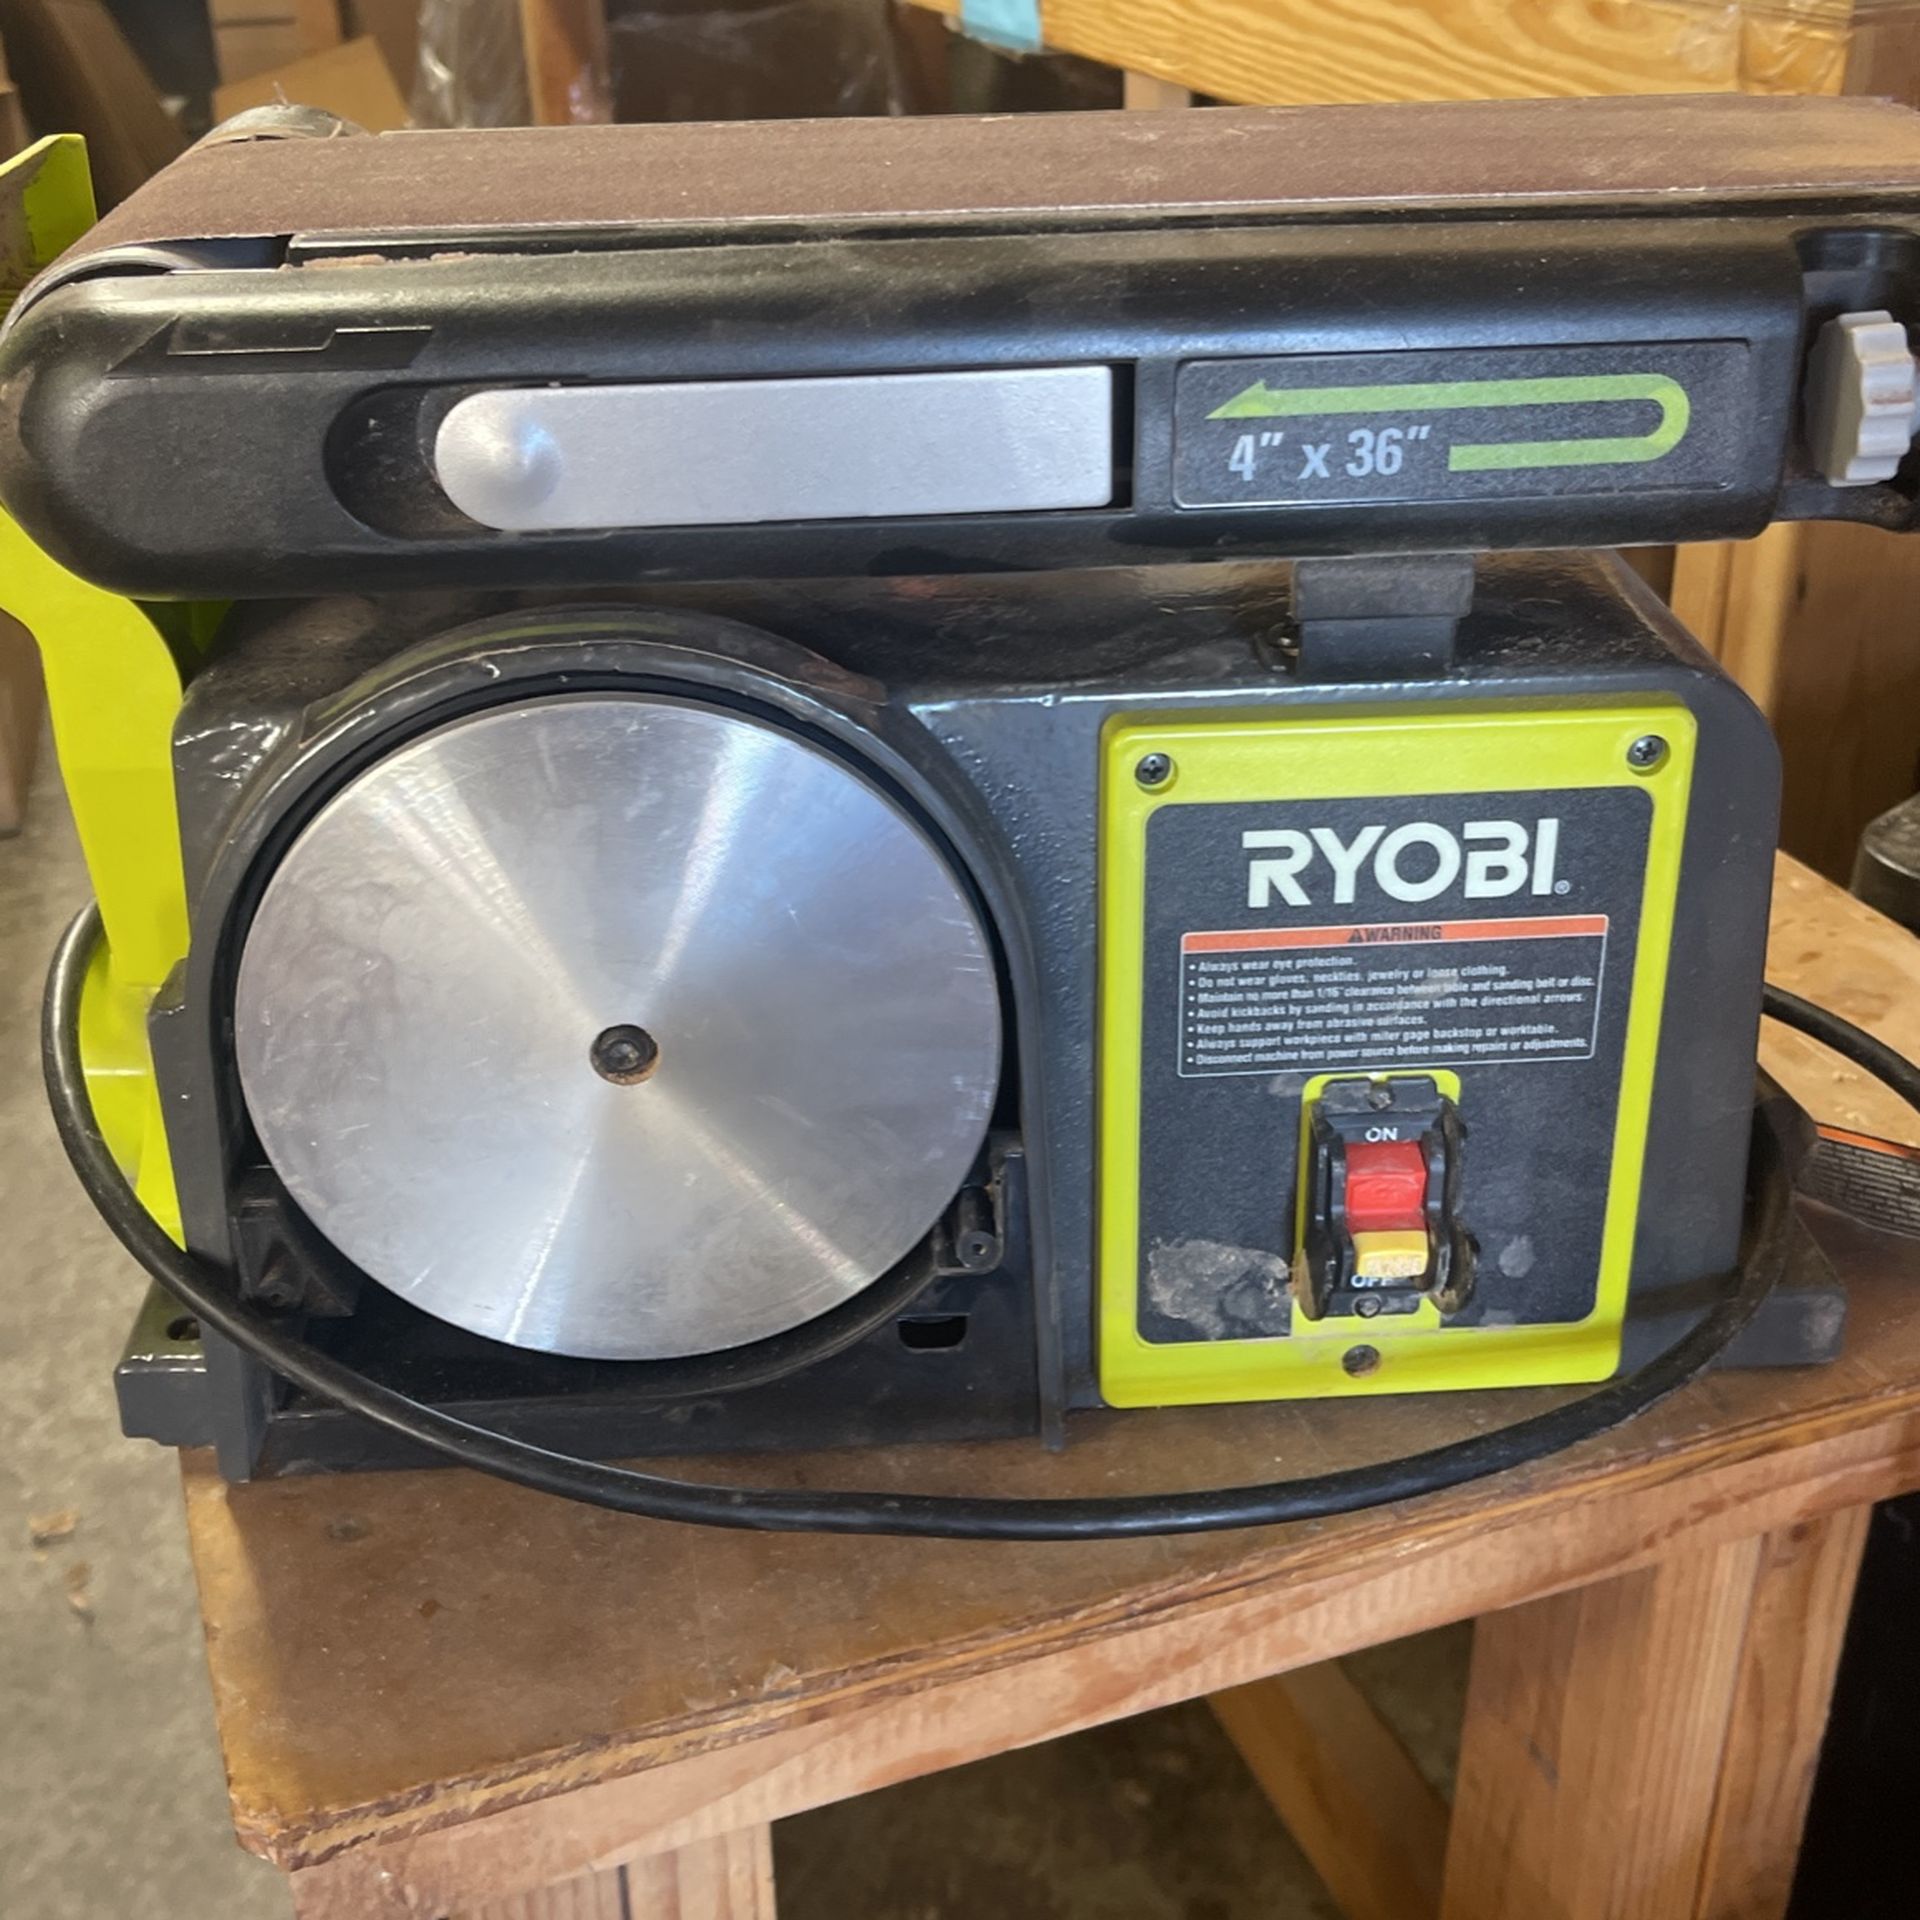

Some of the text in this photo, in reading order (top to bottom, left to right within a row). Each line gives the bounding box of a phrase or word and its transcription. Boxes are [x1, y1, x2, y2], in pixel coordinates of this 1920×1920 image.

[1228, 424, 1432, 481] 4" x 36"
[1242, 818, 1560, 908] RYOBI
[1364, 925, 1442, 943] WARNING
[1198, 957, 1357, 973] Always wear eye protection.
[1198, 977, 1213, 988] Do
[1216, 976, 1236, 987] not
[1237, 976, 1266, 986] wear
[1367, 970, 1410, 982] jewelry
[1412, 969, 1424, 979] or
[1427, 968, 1458, 979] loose
[1460, 965, 1510, 978] clothing.
[1197, 991, 1243, 1004] Maintain
[1245, 992, 1260, 1002] no
[1261, 990, 1289, 1001] more
[1290, 988, 1314, 999] than
[1344, 986, 1395, 998] clearance
[1471, 980, 1491, 992] and
[1492, 979, 1534, 992] sanding
[1535, 977, 1555, 989] belt
[1557, 978, 1569, 988] or
[1197, 1006, 1228, 1018] Avoid
[1231, 1004, 1286, 1017] kickbacks
[1288, 1004, 1302, 1017] by
[1305, 1002, 1349, 1014] sanding
[1352, 1002, 1364, 1012] in
[1366, 999, 1430, 1012] accordance
[1432, 997, 1457, 1009] with
[1459, 995, 1478, 1008] the
[1480, 993, 1541, 1007] directional
[1197, 1023, 1226, 1036] Keep
[1227, 1021, 1262, 1033] hands
[1264, 1021, 1294, 1032] away
[1296, 1019, 1323, 1030] from
[1326, 1017, 1374, 1029] abrasive
[1196, 1038, 1236, 1050] Always
[1238, 1036, 1282, 1049] support
[1283, 1034, 1341, 1047] workpiece
[1343, 1031, 1368, 1043] with
[1432, 1027, 1482, 1040] backstop
[1485, 1028, 1498, 1038] or
[1196, 1052, 1252, 1065] Disconnect
[1253, 1050, 1299, 1062] machine
[1300, 1049, 1324, 1061] from
[1510, 1041, 1522, 1052] or
[1365, 1127, 1398, 1142] ON
